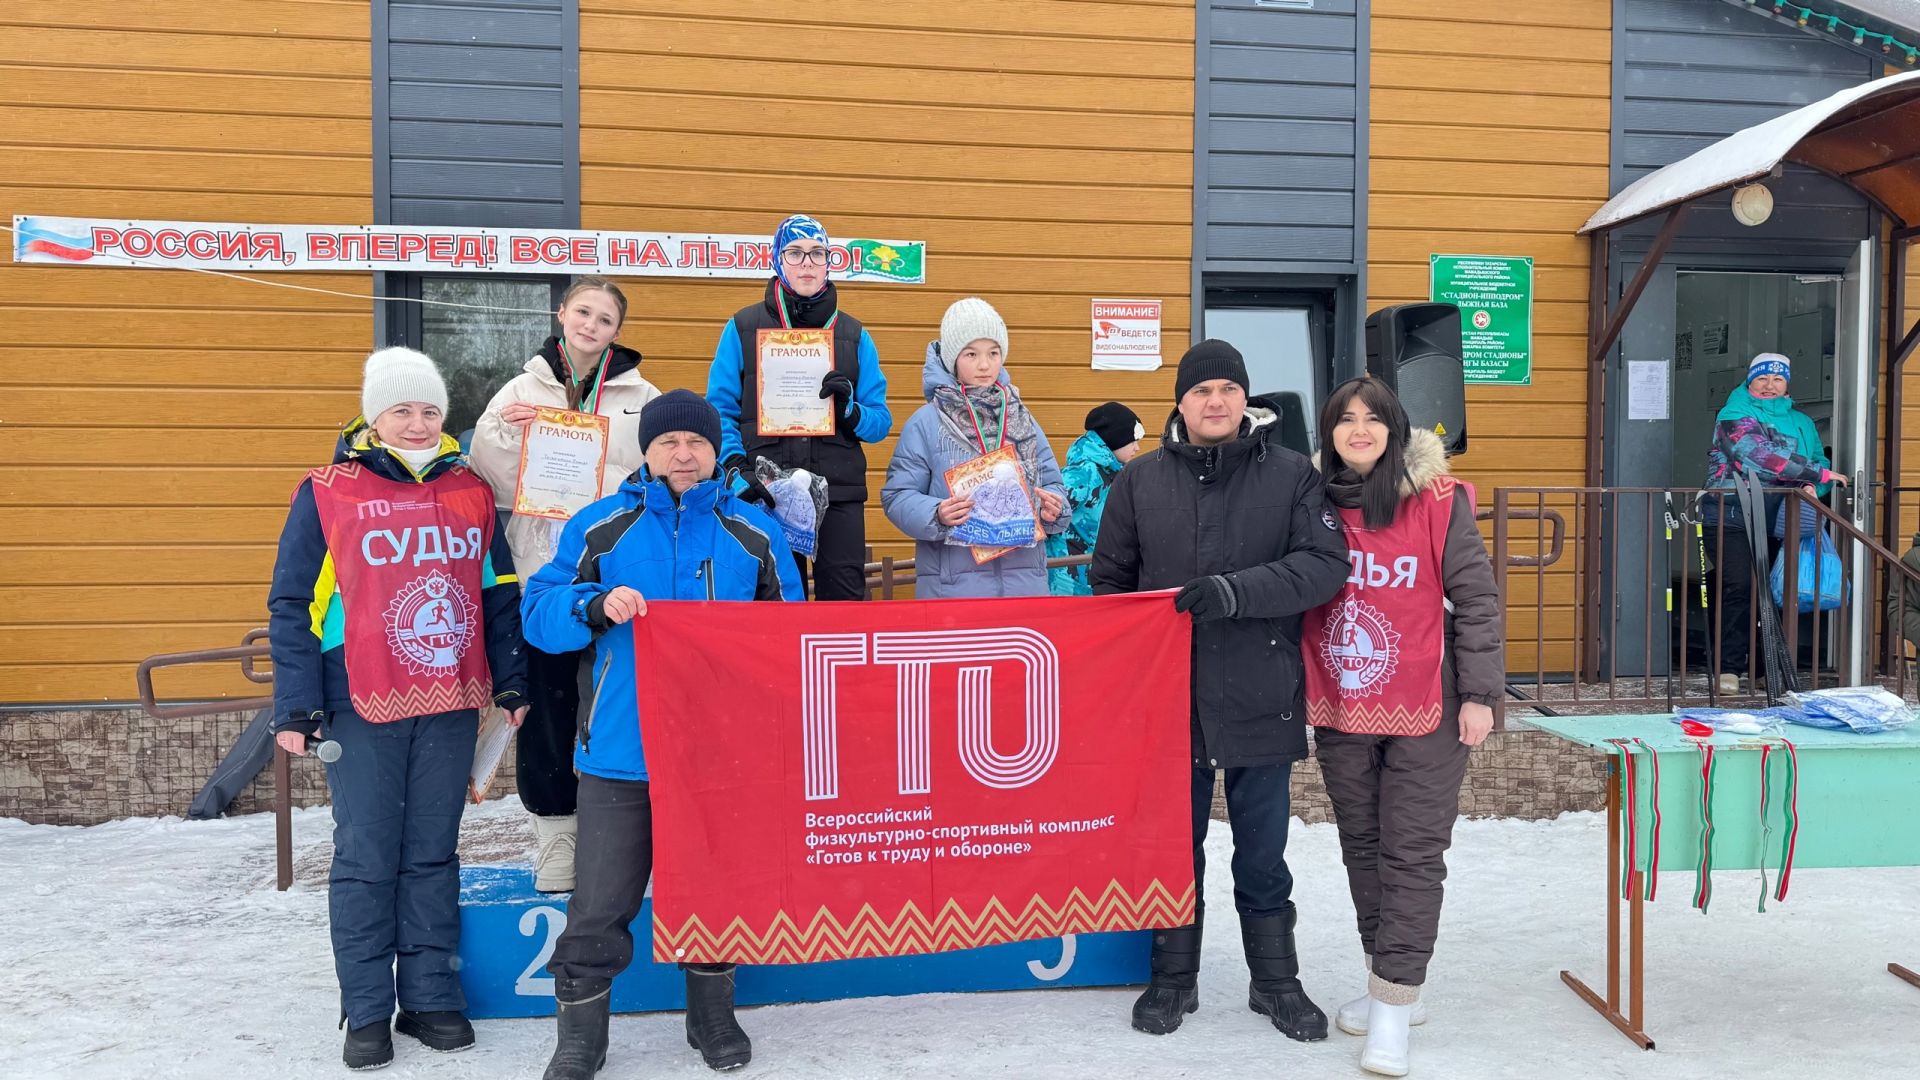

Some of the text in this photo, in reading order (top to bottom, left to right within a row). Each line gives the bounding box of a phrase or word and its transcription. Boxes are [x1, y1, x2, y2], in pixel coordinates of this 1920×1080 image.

[91, 227, 296, 266] РОССИЯ,
[306, 233, 498, 267] ВПЕРЕД!
[510, 236, 599, 266] ВСЕ
[608, 238, 672, 268] НА
[1095, 306, 1158, 317] ВНИМАНИЕ!
[1121, 329, 1157, 338] ВЕДЕТСЯ
[770, 348, 821, 357] ГРАМОТА
[539, 425, 593, 442] ГРАМОТА
[356, 499, 391, 520] ГТО
[961, 523, 989, 538] 2025
[361, 526, 482, 567] СУДЬЯ
[1346, 550, 1418, 590] ДЬЯ
[429, 633, 456, 646] ГТО
[1340, 657, 1363, 668] ГТО
[801, 627, 1060, 800] ГТО
[805, 805, 932, 828] Всероссийский
[805, 814, 1115, 849] физкультурно-спортивный комплекс
[806, 841, 1032, 865] «Готов к труду и обороне»
[515, 906, 568, 996] 2
